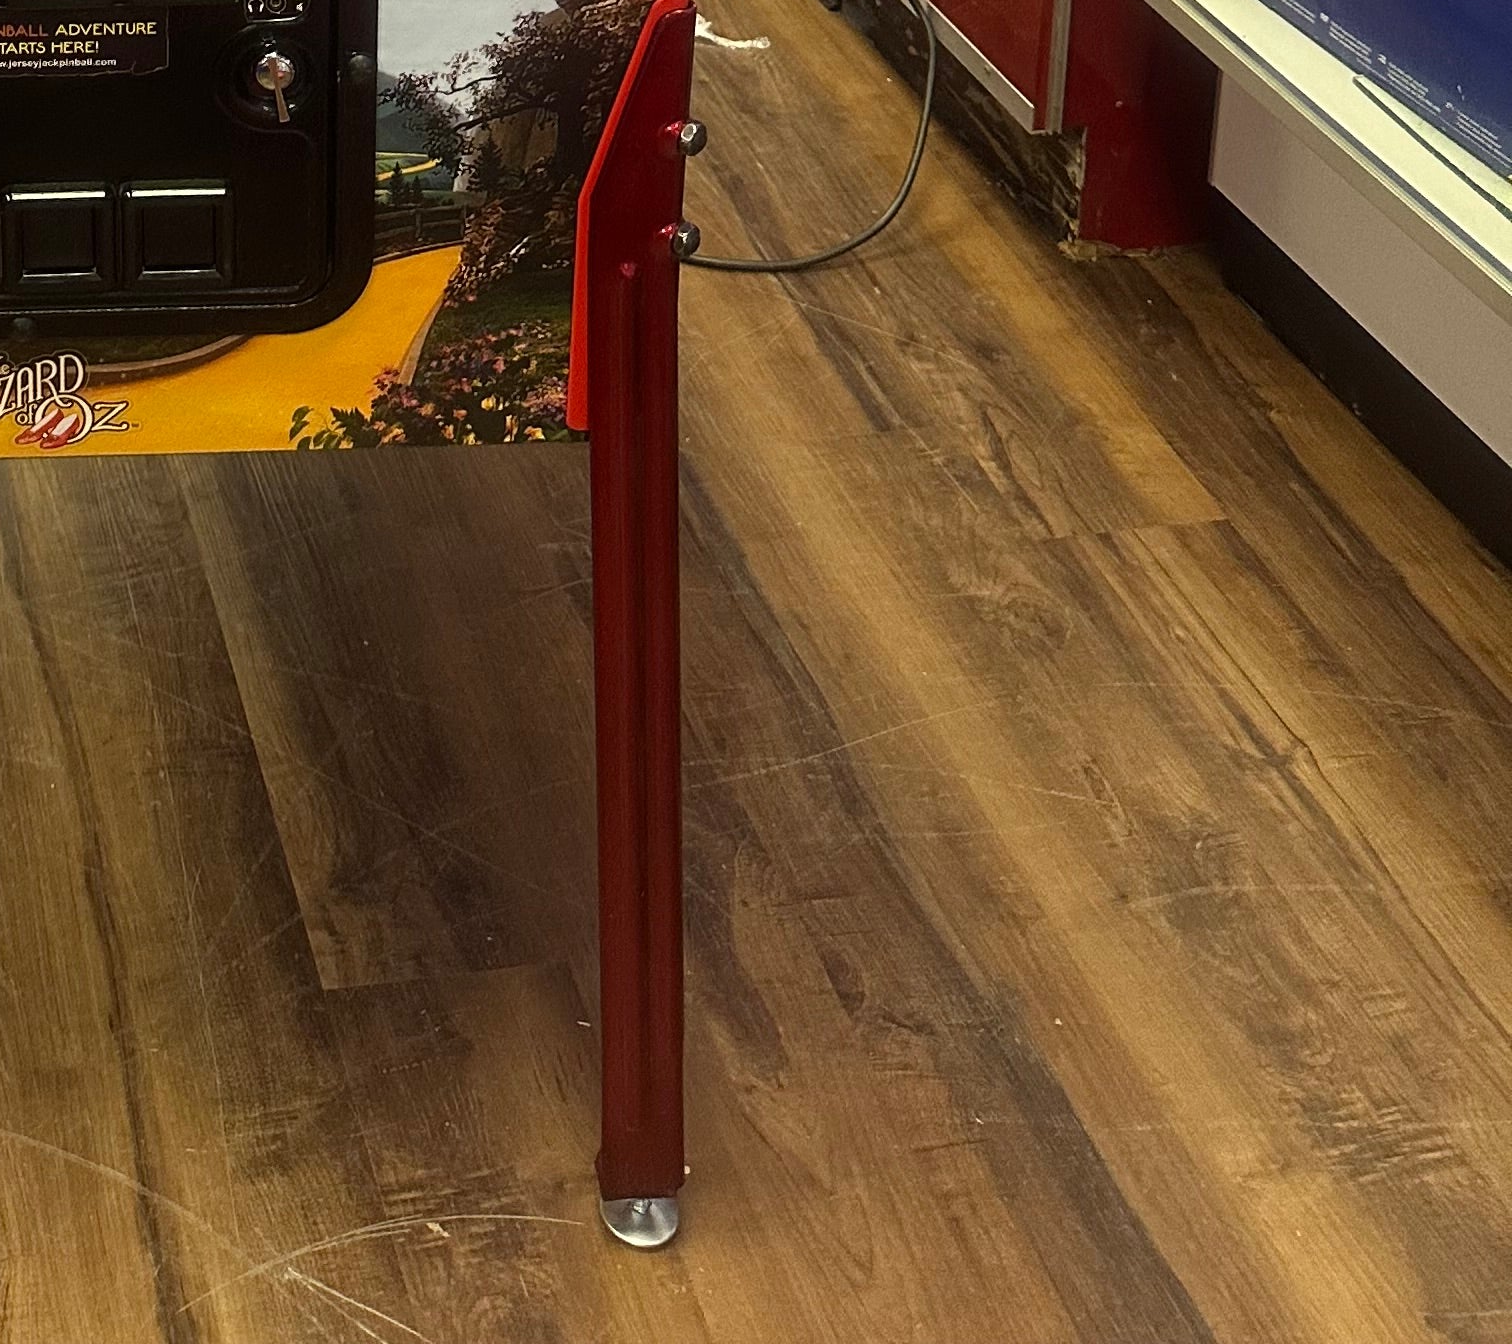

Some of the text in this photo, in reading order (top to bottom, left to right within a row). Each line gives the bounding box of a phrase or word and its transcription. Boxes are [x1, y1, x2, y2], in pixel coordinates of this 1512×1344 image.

[54, 22, 157, 37] ADVENTURE
[51, 40, 100, 54] HERE!
[16, 401, 38, 426] of
